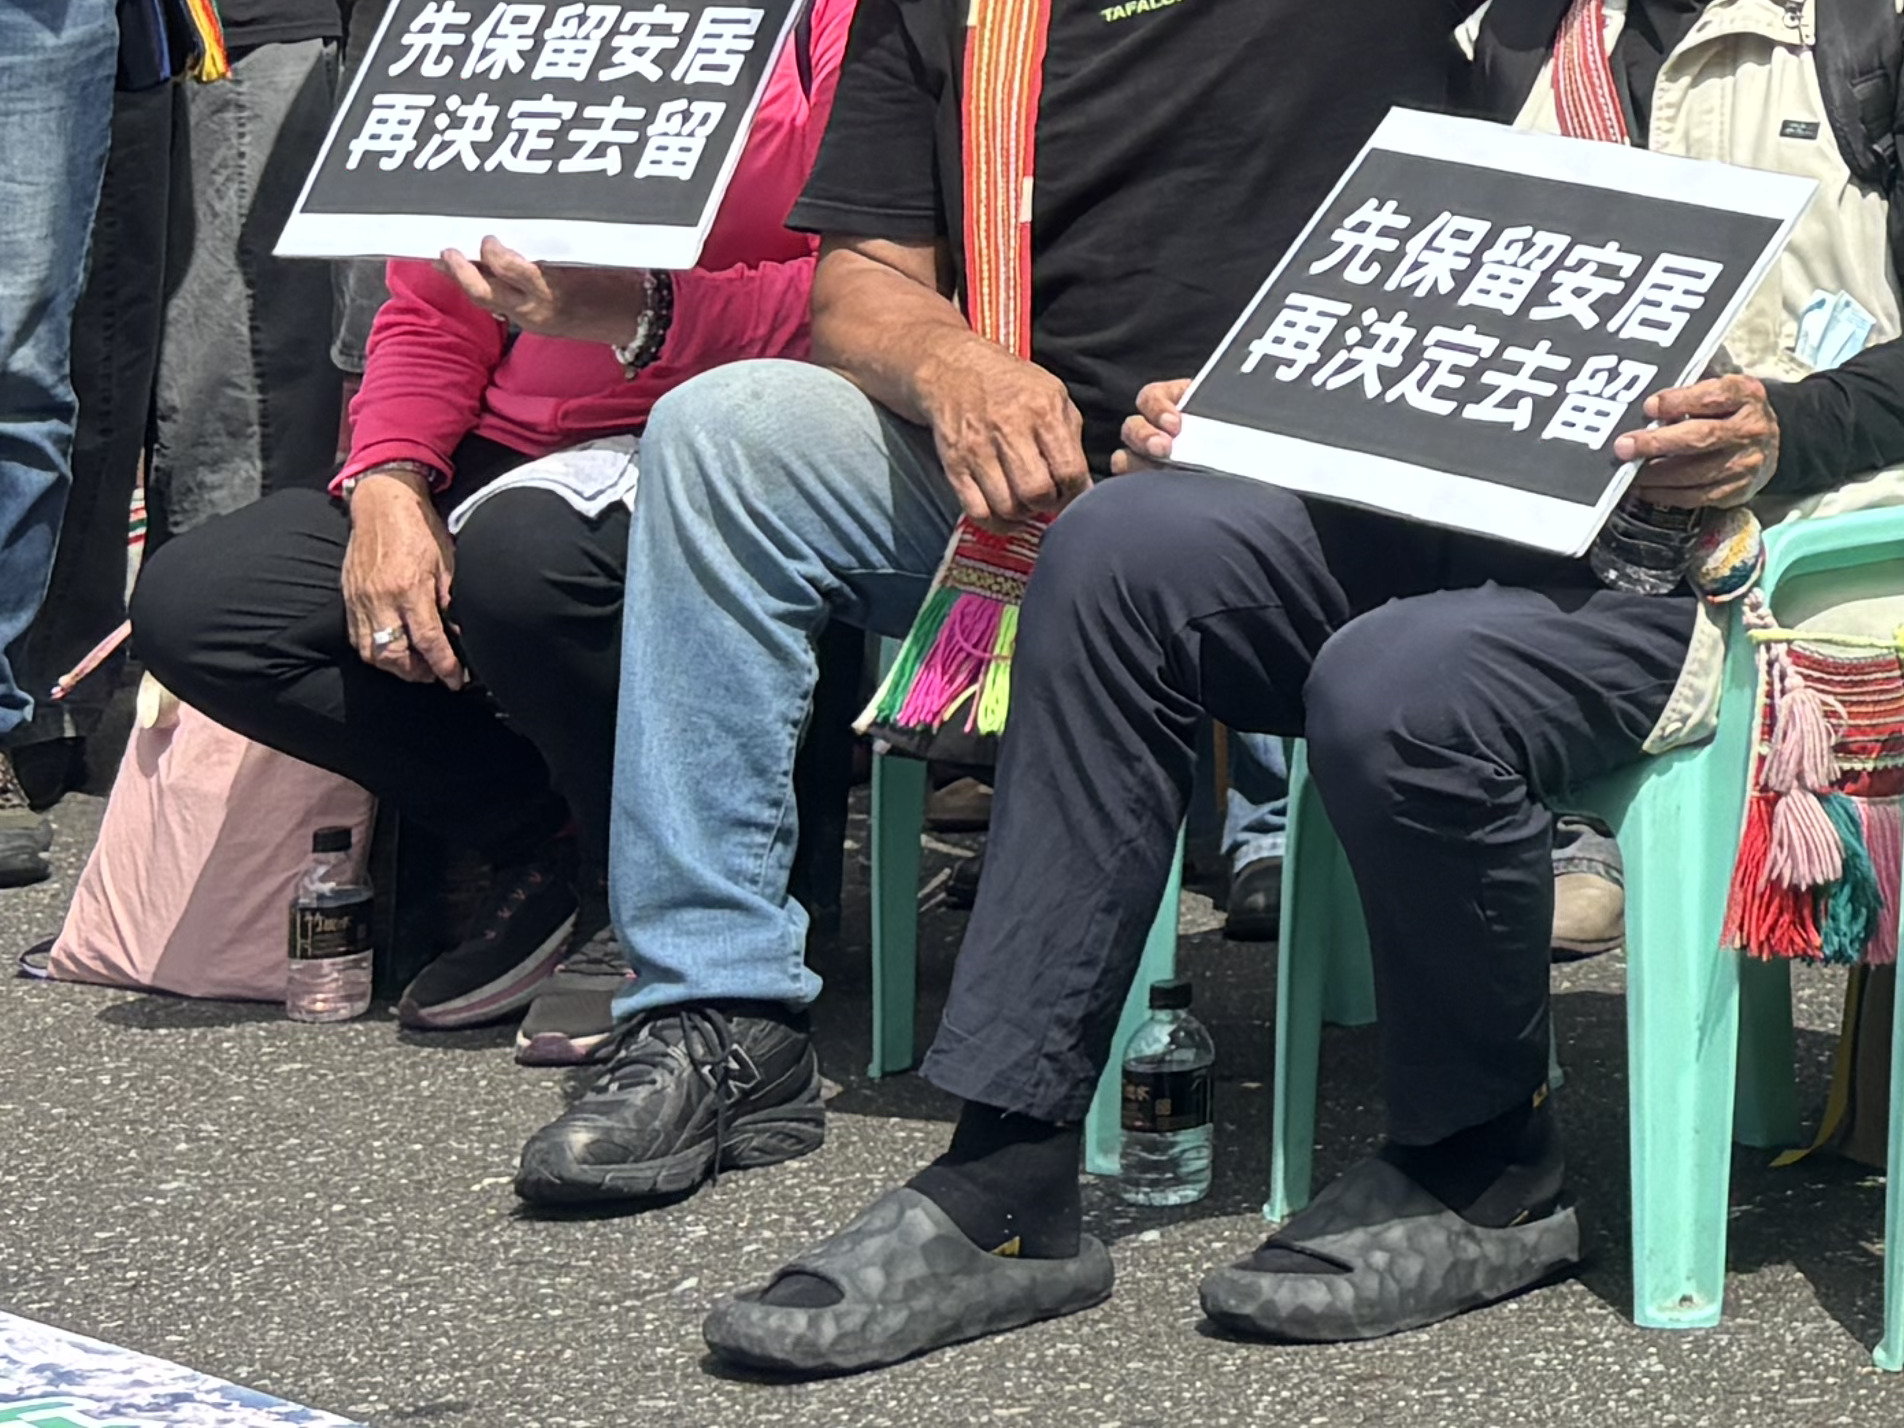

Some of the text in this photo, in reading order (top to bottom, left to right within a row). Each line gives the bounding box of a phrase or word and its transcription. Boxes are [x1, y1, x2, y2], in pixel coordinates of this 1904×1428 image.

[389, 1, 764, 85] 先保留安居
[347, 93, 725, 180] 再決定去留
[1309, 197, 1723, 346] 先保留安居
[1241, 292, 1656, 450] 再決定去留
